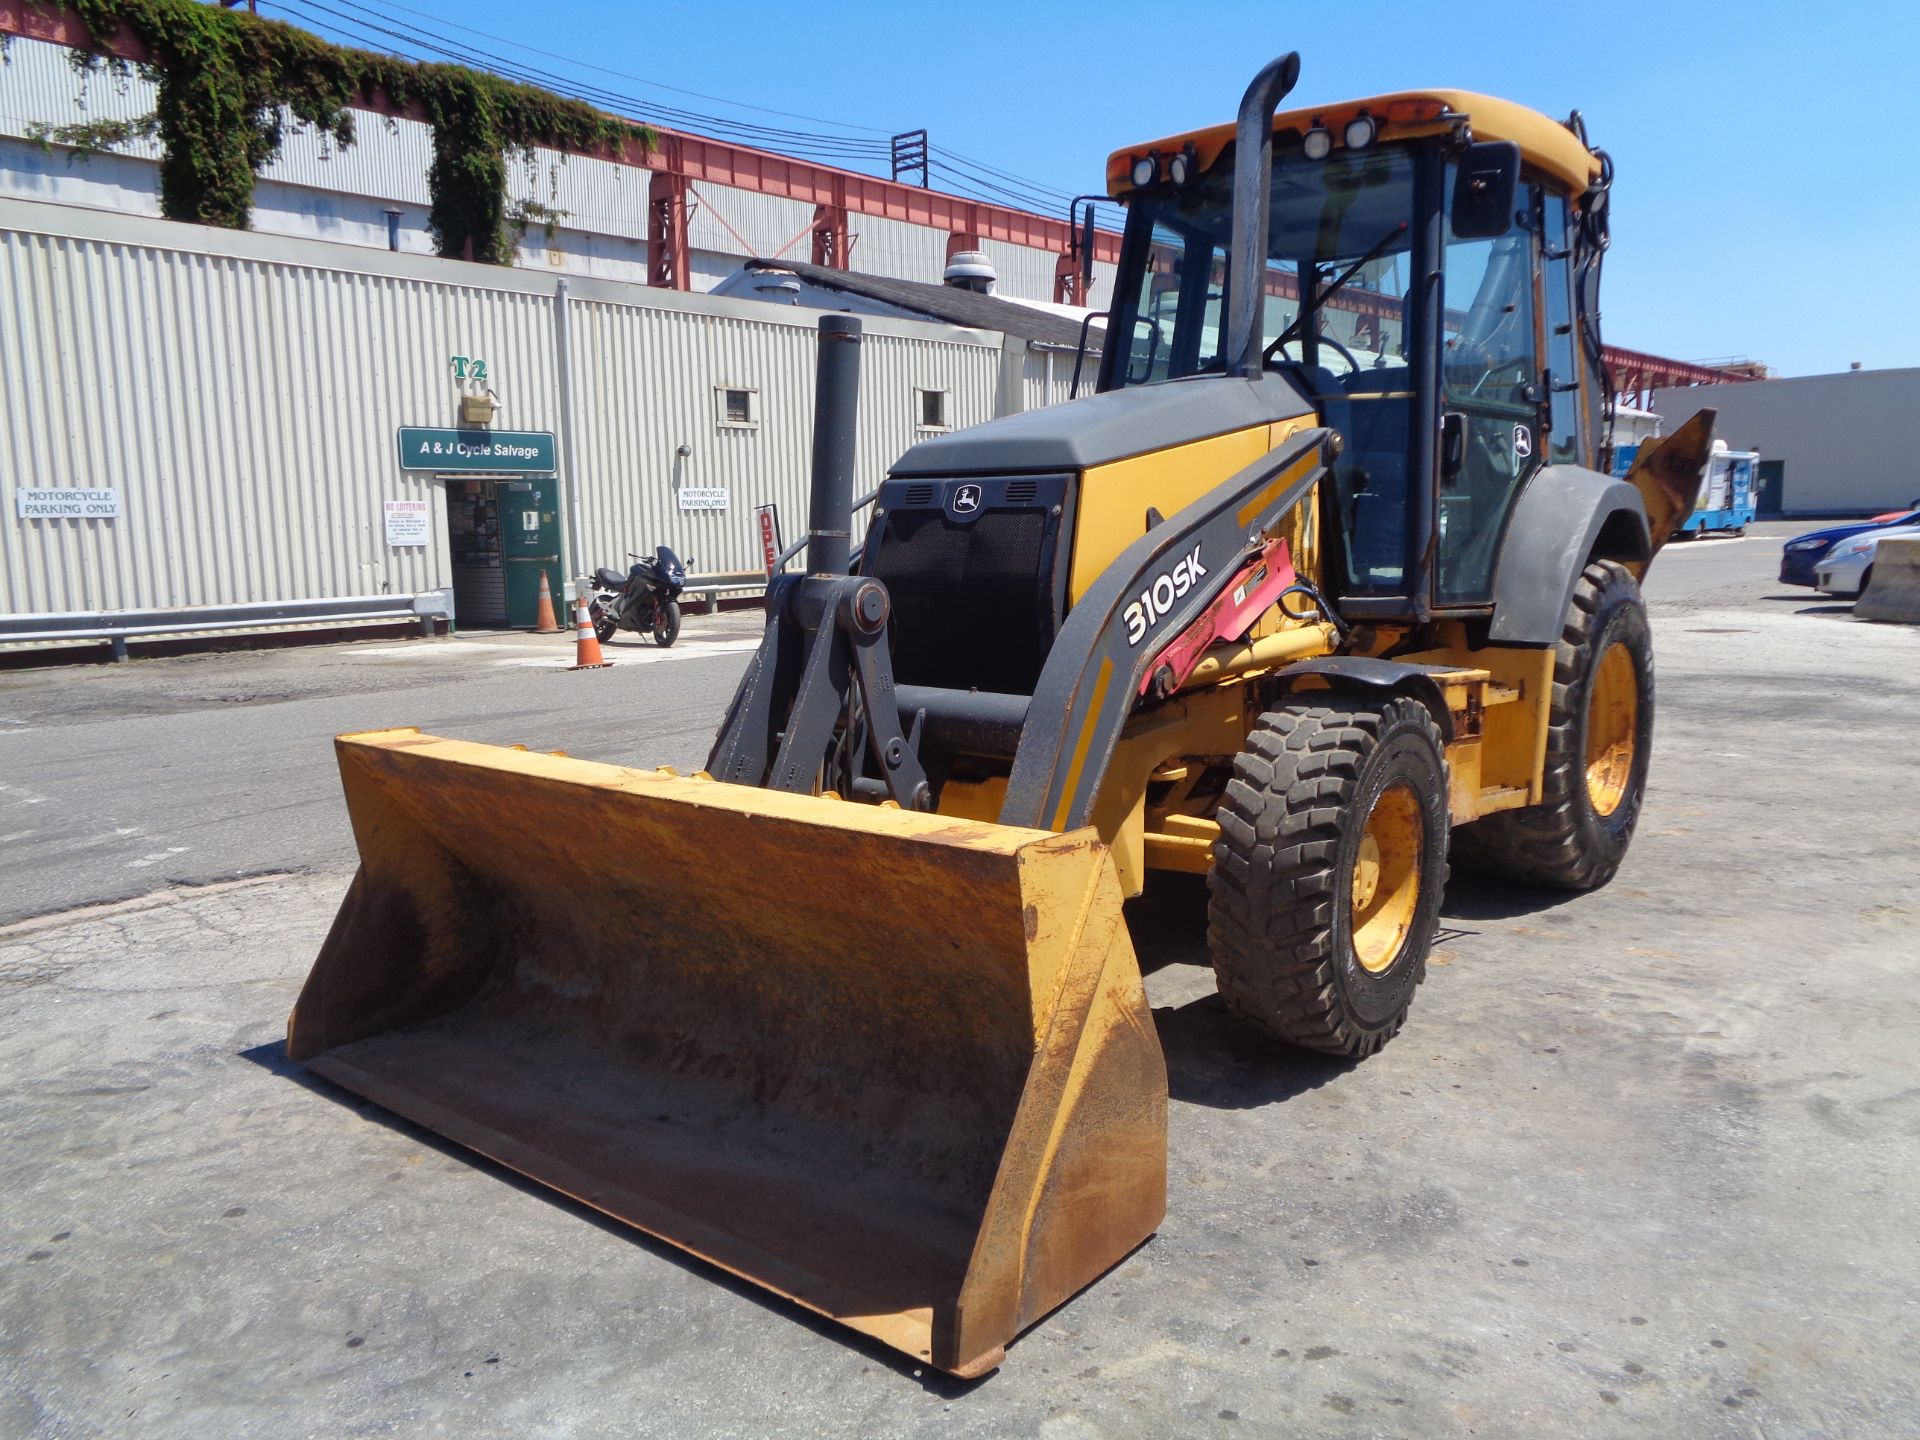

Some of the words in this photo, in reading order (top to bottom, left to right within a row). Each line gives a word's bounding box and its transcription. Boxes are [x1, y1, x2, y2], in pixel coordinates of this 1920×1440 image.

[420, 442, 431, 454] A
[433, 442, 443, 454] &
[446, 443, 453, 455] J
[457, 443, 491, 458] Cycle
[494, 445, 539, 459] Salvage
[27, 491, 112, 501] MOTORCYCLE
[683, 490, 725, 498] MOTORCYCLE
[385, 502, 394, 511] NO
[396, 502, 426, 511] LOITERING
[682, 499, 710, 507] PARKING
[711, 499, 727, 507] ONLY
[25, 504, 81, 514] PARKING
[86, 504, 116, 514] ONLY
[1123, 543, 1208, 647] 310SK
